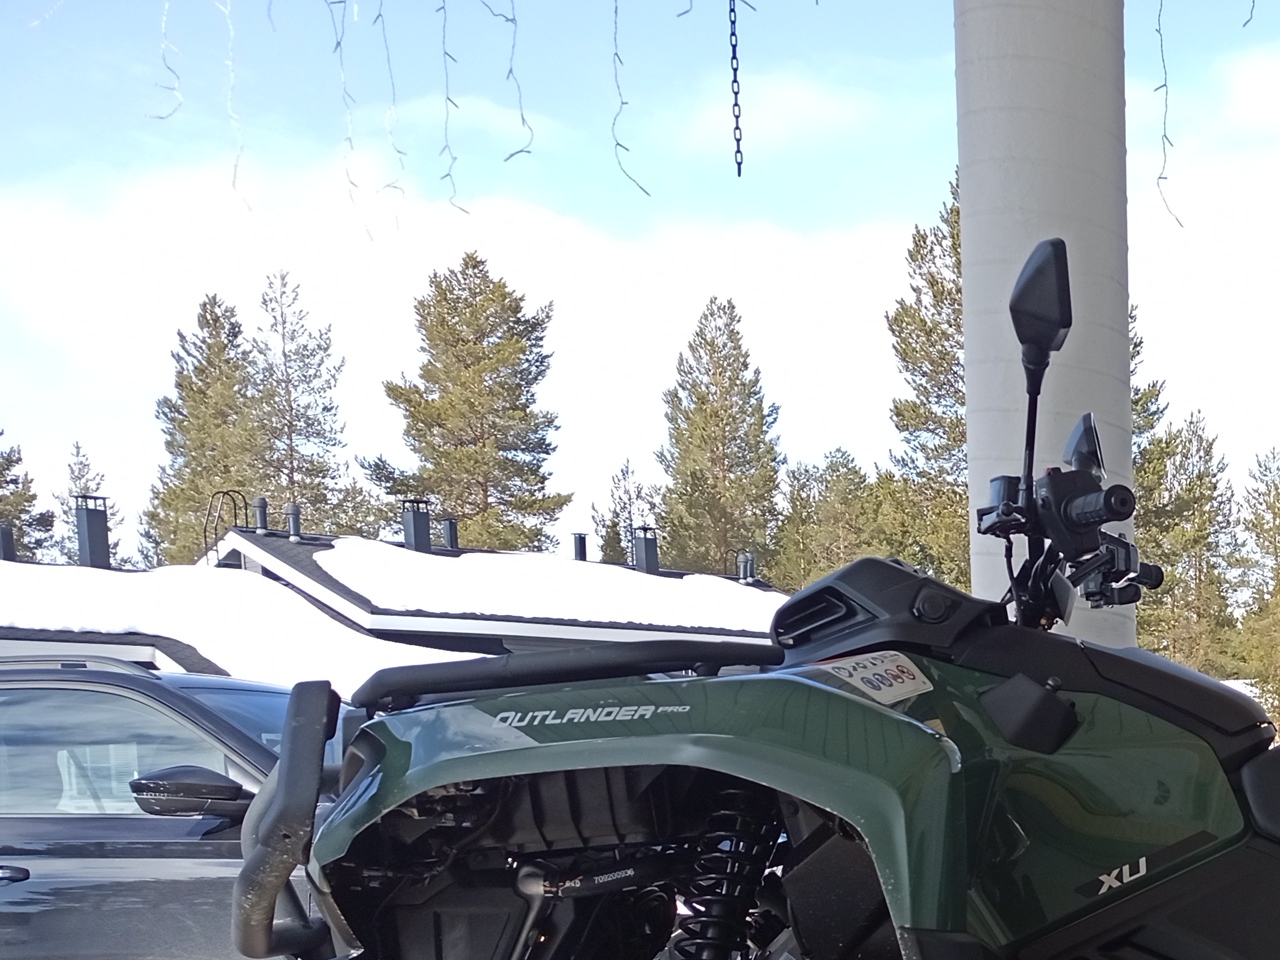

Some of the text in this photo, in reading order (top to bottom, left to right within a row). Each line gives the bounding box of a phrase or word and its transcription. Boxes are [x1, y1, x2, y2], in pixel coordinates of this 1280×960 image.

[492, 705, 691, 728] OUTLANDER PRO
[1098, 856, 1147, 895] XU
